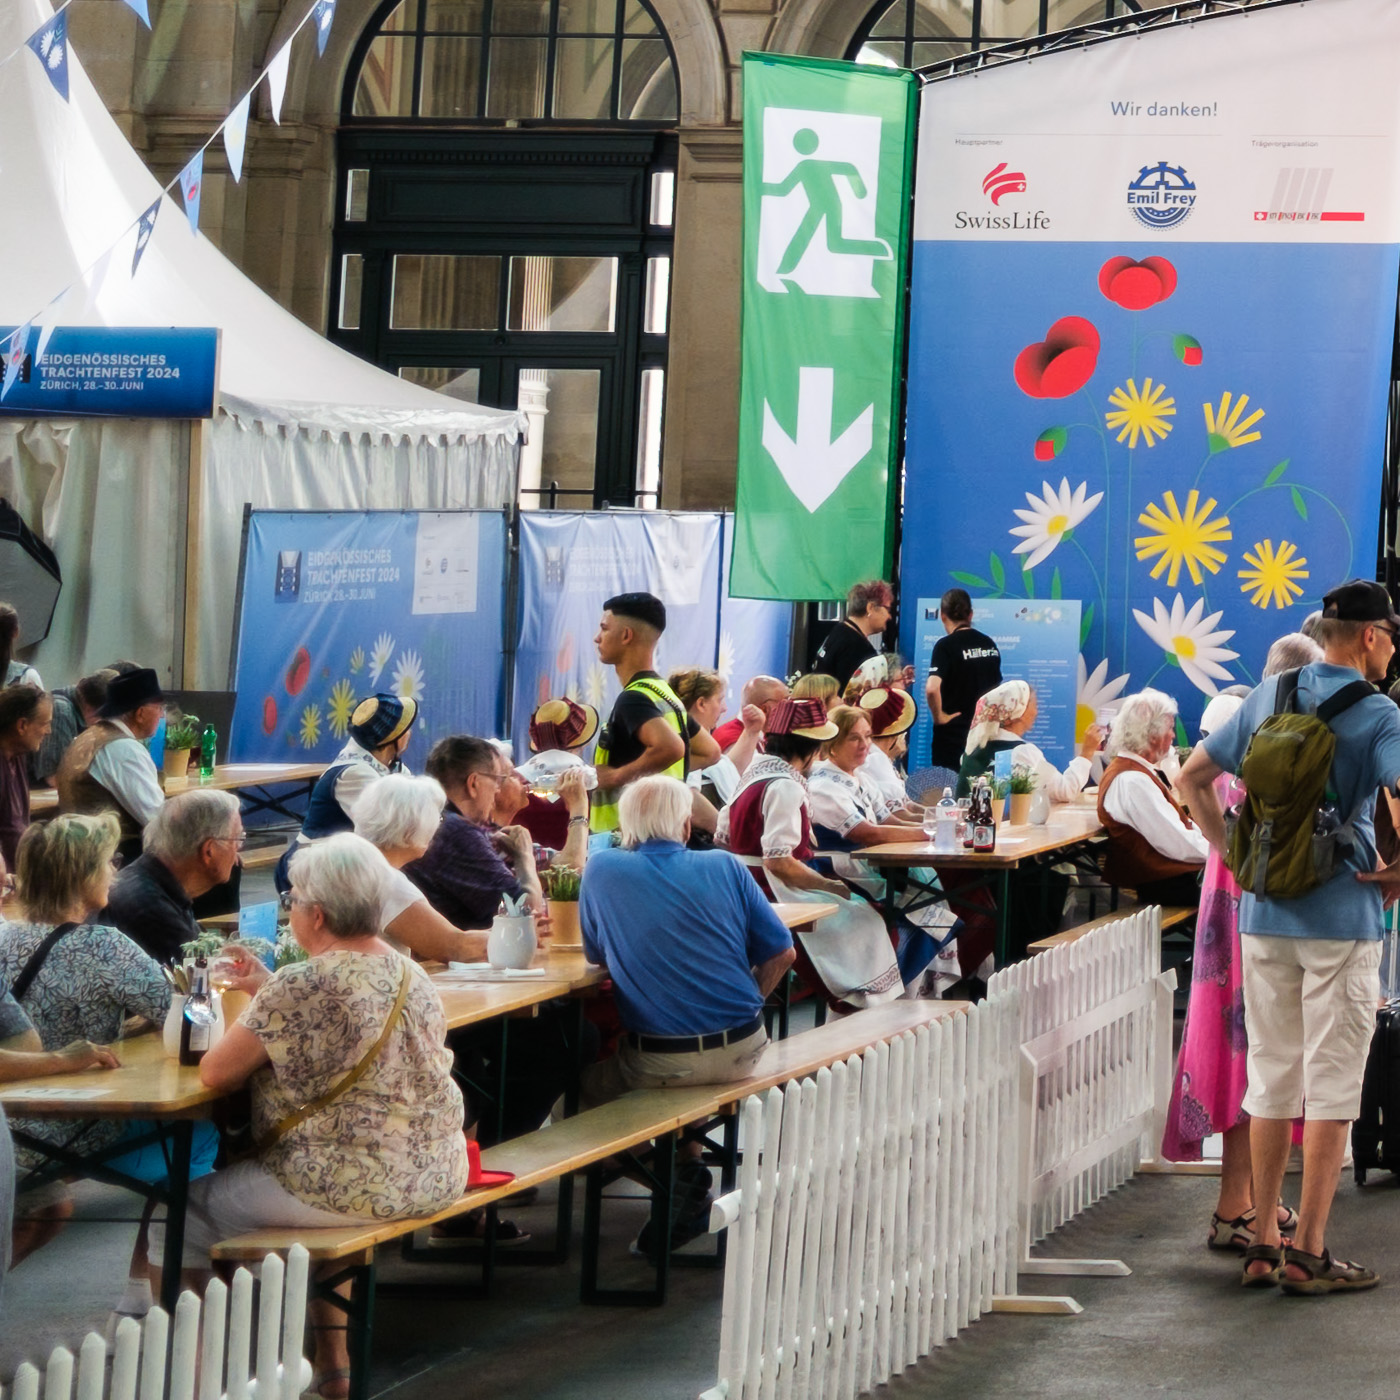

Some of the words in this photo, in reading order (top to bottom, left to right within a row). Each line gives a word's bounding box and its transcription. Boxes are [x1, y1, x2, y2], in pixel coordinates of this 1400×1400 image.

[1111, 101, 1142, 116] Wir
[1147, 102, 1218, 117] danken!
[1127, 192, 1159, 204] Emil
[1164, 193, 1197, 207] Frey
[40, 353, 166, 366] EIDGENÖSSISCHES
[40, 367, 143, 378] TRACHTENFEST
[146, 368, 180, 379] 2024
[307, 567, 377, 586] TRACHTENFEST
[378, 567, 400, 582] 2024
